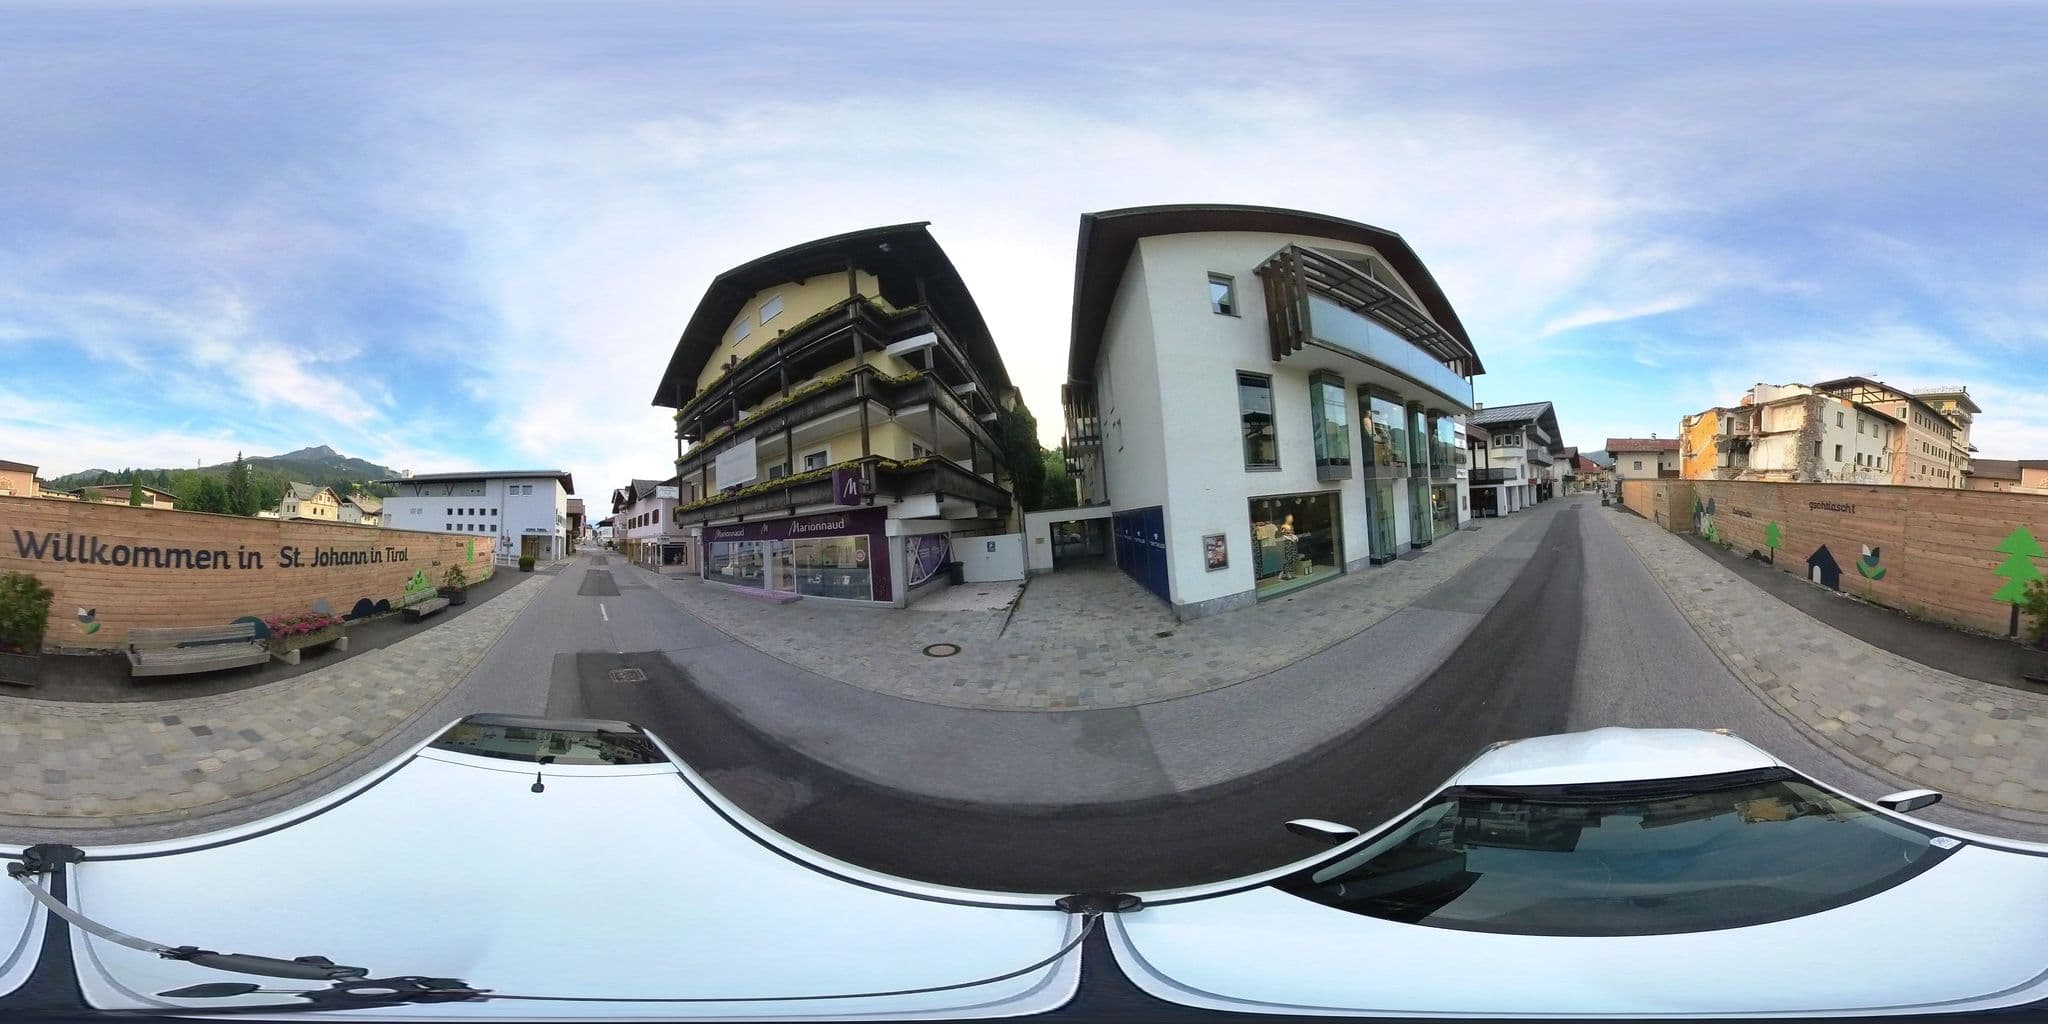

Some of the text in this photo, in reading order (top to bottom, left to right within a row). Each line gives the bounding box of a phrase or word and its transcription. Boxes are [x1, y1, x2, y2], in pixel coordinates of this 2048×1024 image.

[843, 477, 857, 498] M
[715, 528, 745, 540] Marionnaud
[788, 518, 845, 536] Marionnaud
[12, 529, 408, 569] Willkommen in St. Johann in Tirol
